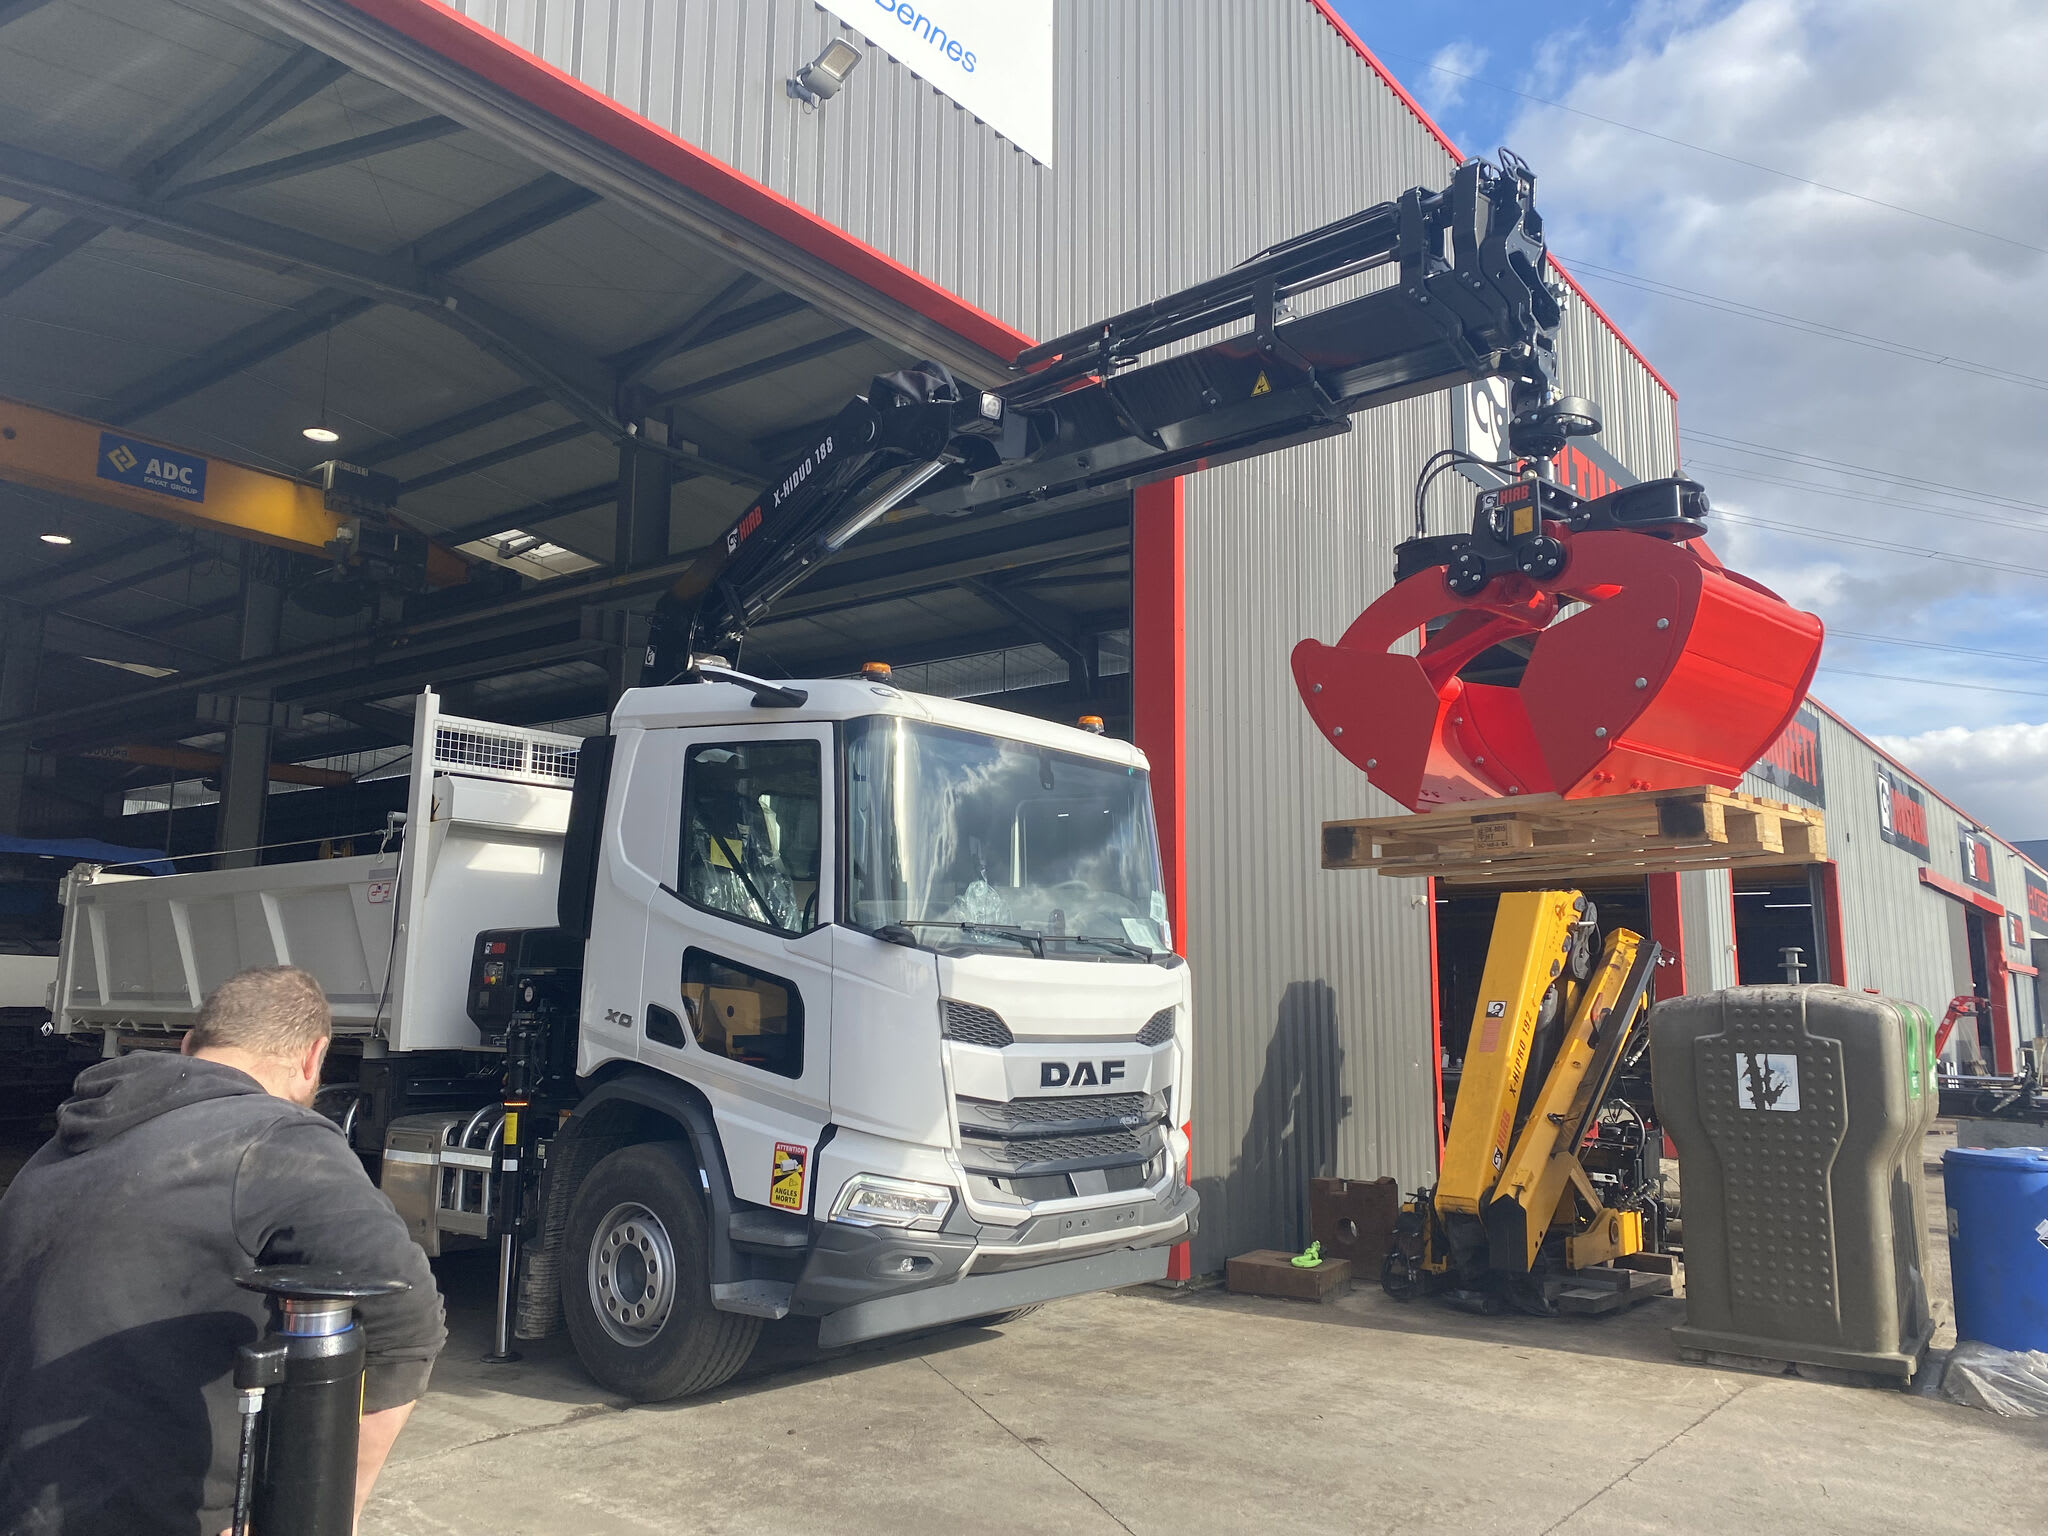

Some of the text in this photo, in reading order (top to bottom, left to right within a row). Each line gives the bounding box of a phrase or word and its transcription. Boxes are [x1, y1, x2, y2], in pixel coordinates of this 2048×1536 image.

[145, 458, 193, 485] ADC
[773, 436, 833, 508] X-HIDUO 188
[170, 483, 198, 495] GROUP
[1500, 484, 1530, 505] HIAB
[739, 505, 763, 543] HIAB
[1508, 1009, 1533, 1098] X-HIPRO 192
[1040, 1060, 1125, 1088] DAF
[776, 1143, 806, 1154] ATTENTION
[775, 1186, 798, 1197] ANGLES
[775, 1194, 796, 1205] MORTS
